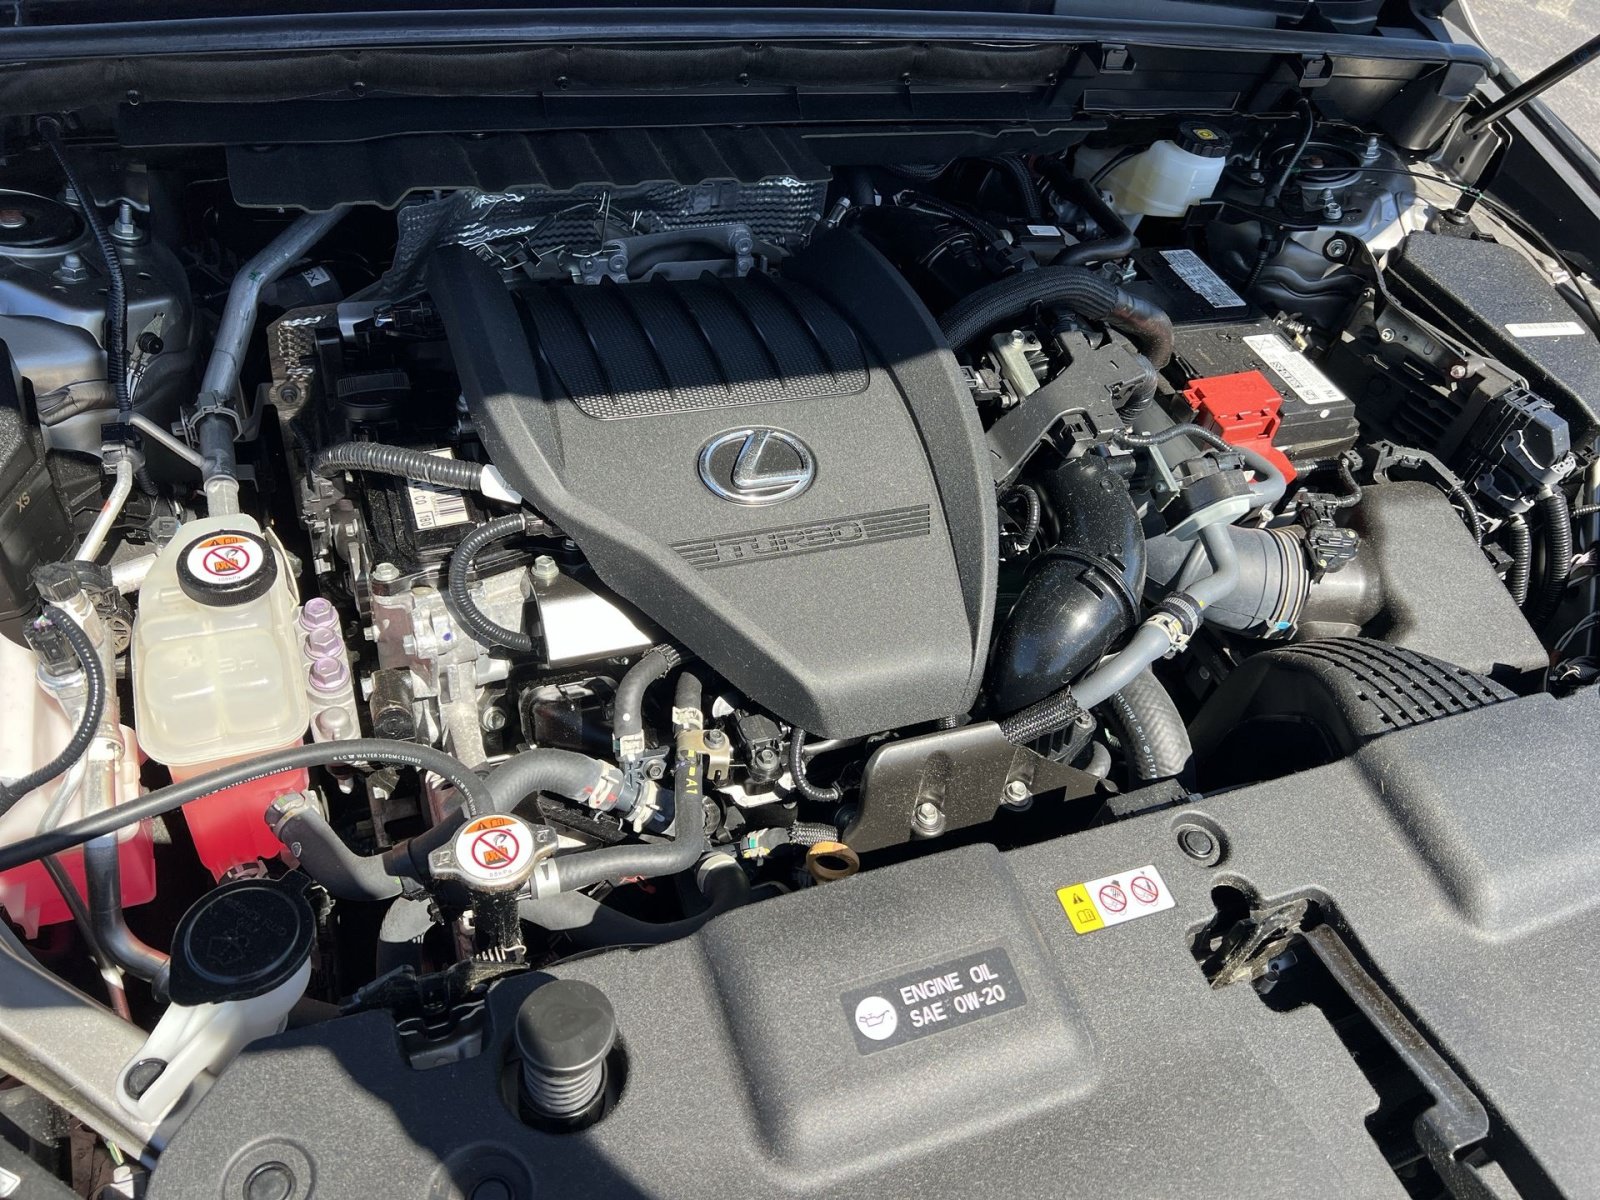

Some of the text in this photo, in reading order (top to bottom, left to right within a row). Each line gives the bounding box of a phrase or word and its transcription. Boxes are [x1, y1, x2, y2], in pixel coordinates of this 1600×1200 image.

[686, 778, 699, 795] A1
[899, 963, 999, 1005] ENGINE OIL
[909, 984, 1006, 1028] SAE 0W-20
